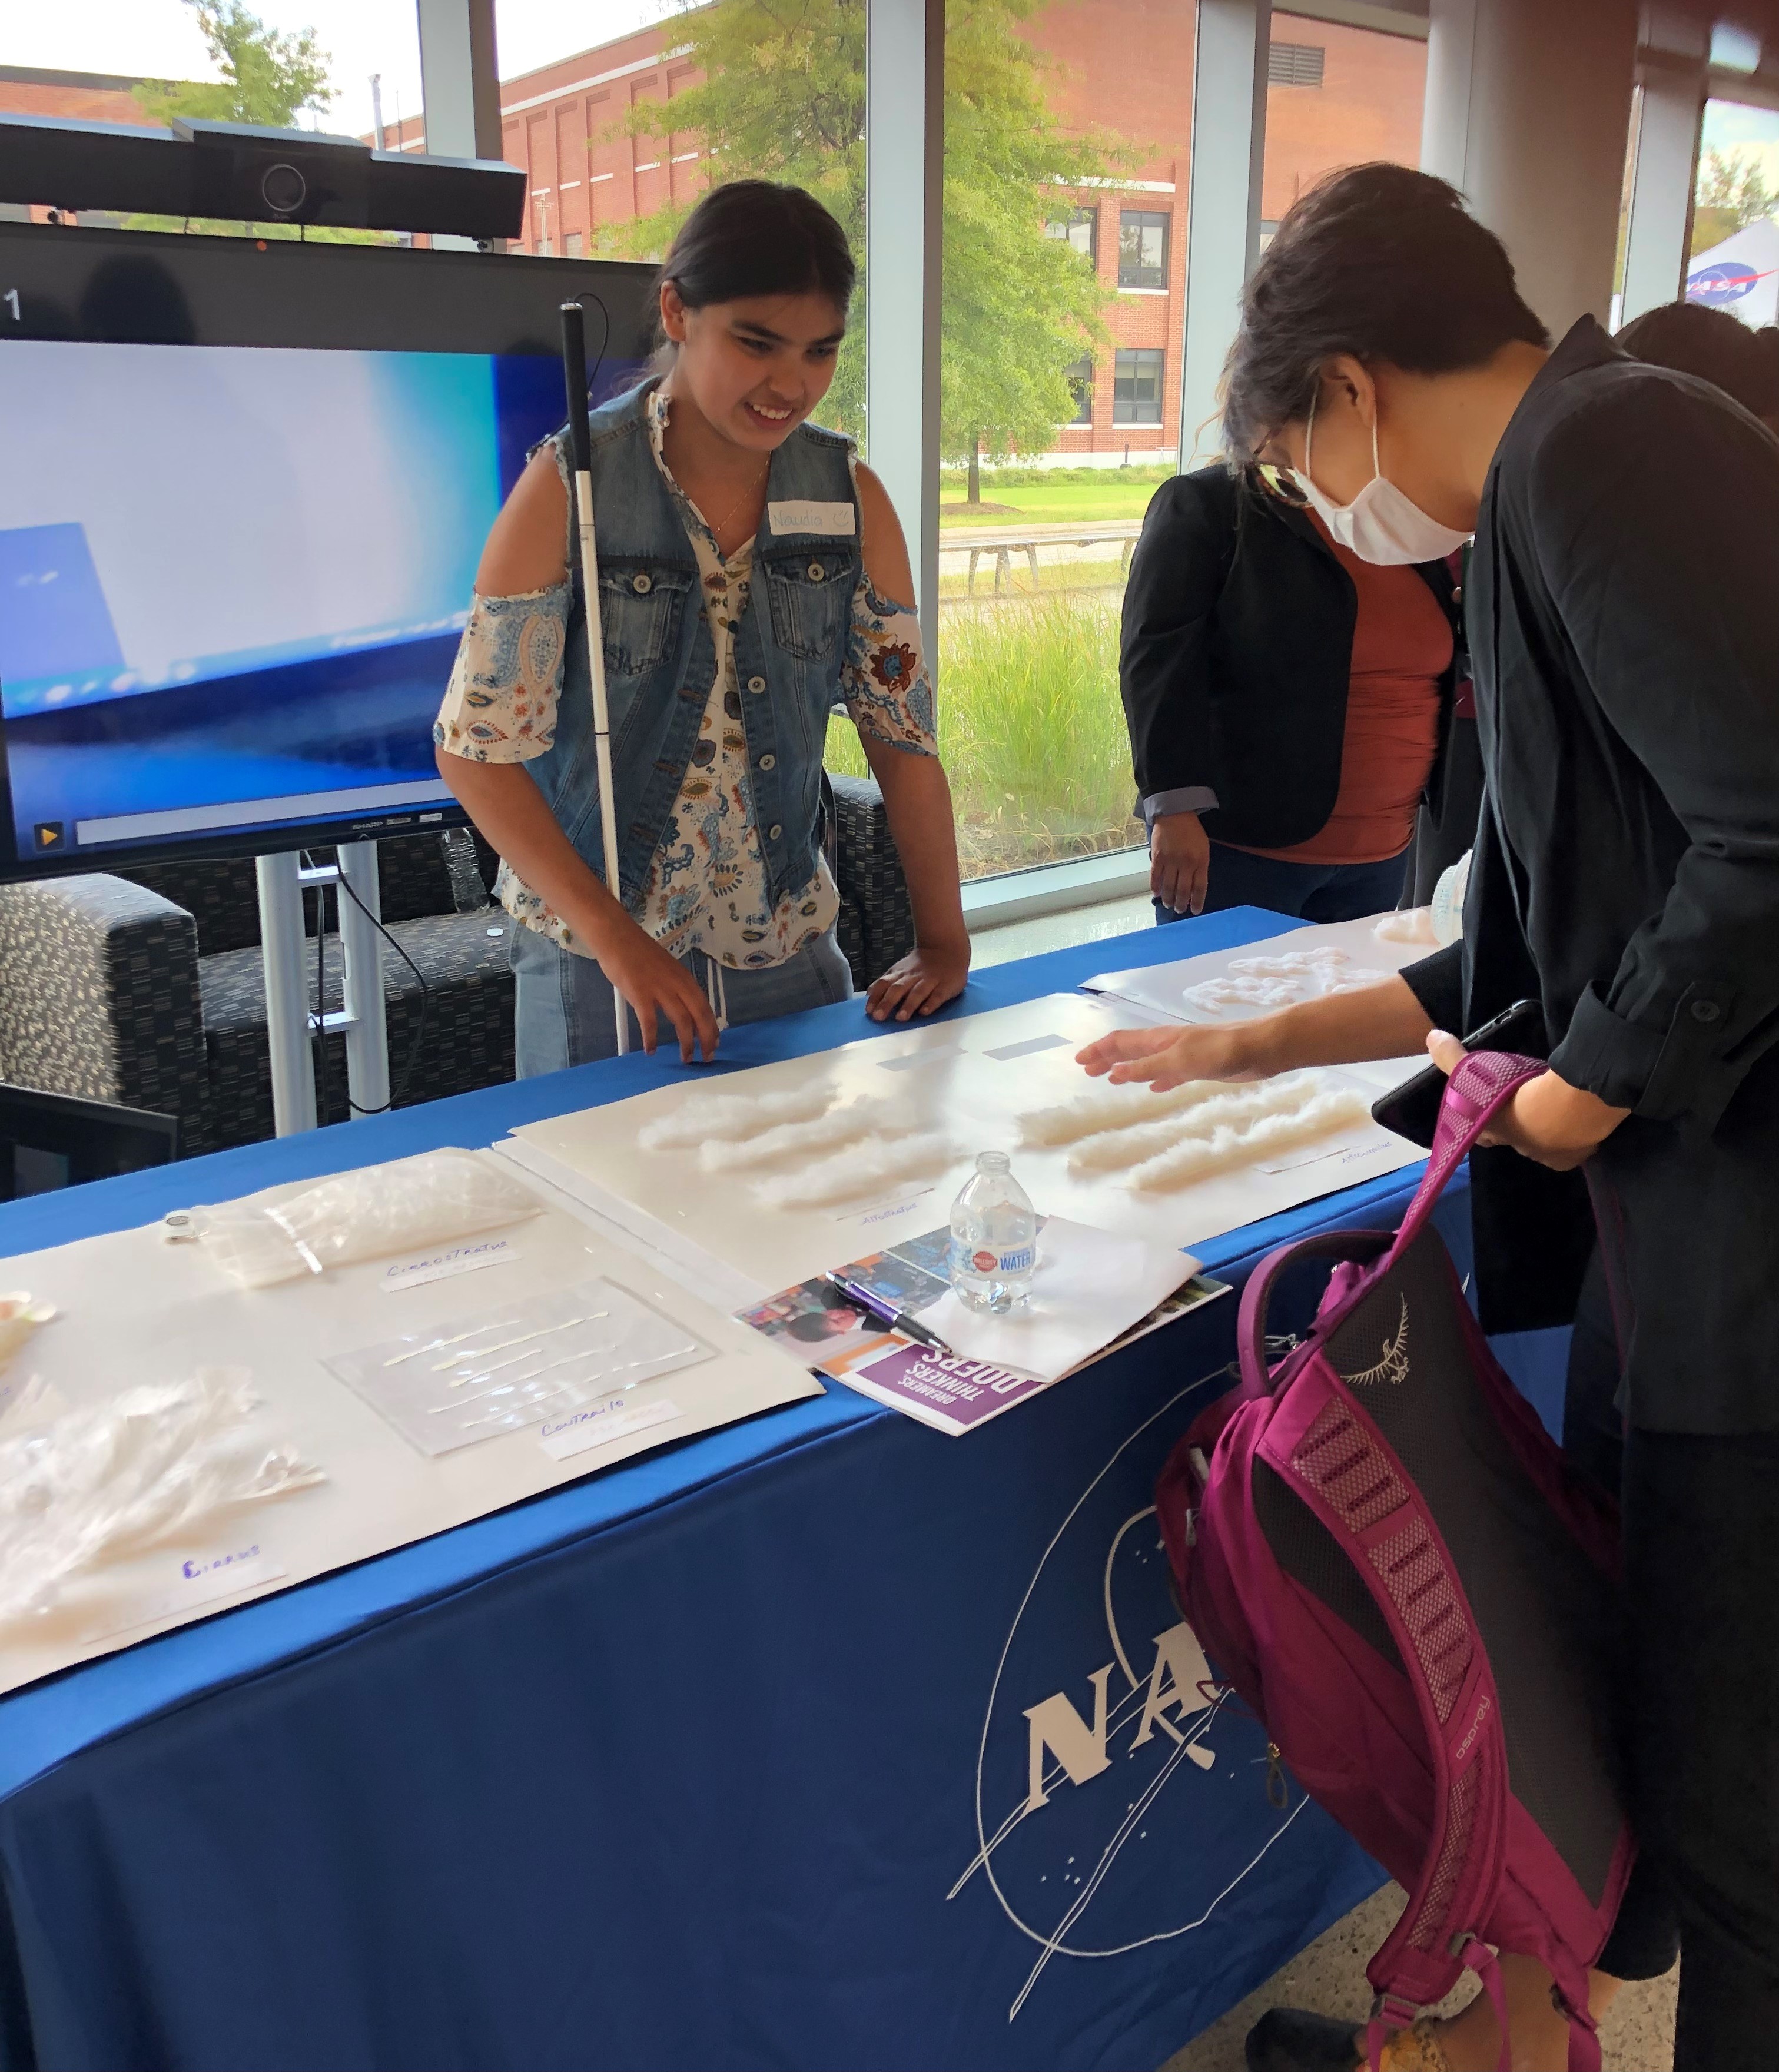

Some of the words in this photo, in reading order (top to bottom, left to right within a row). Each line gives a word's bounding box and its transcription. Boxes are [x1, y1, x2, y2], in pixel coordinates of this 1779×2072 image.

[4, 289, 21, 320] 1
[353, 821, 383, 830] SHARP
[1000, 1252, 1031, 1271] WATER
[1021, 1621, 1222, 1819] NA
[1456, 1695, 1491, 1759] osprey
